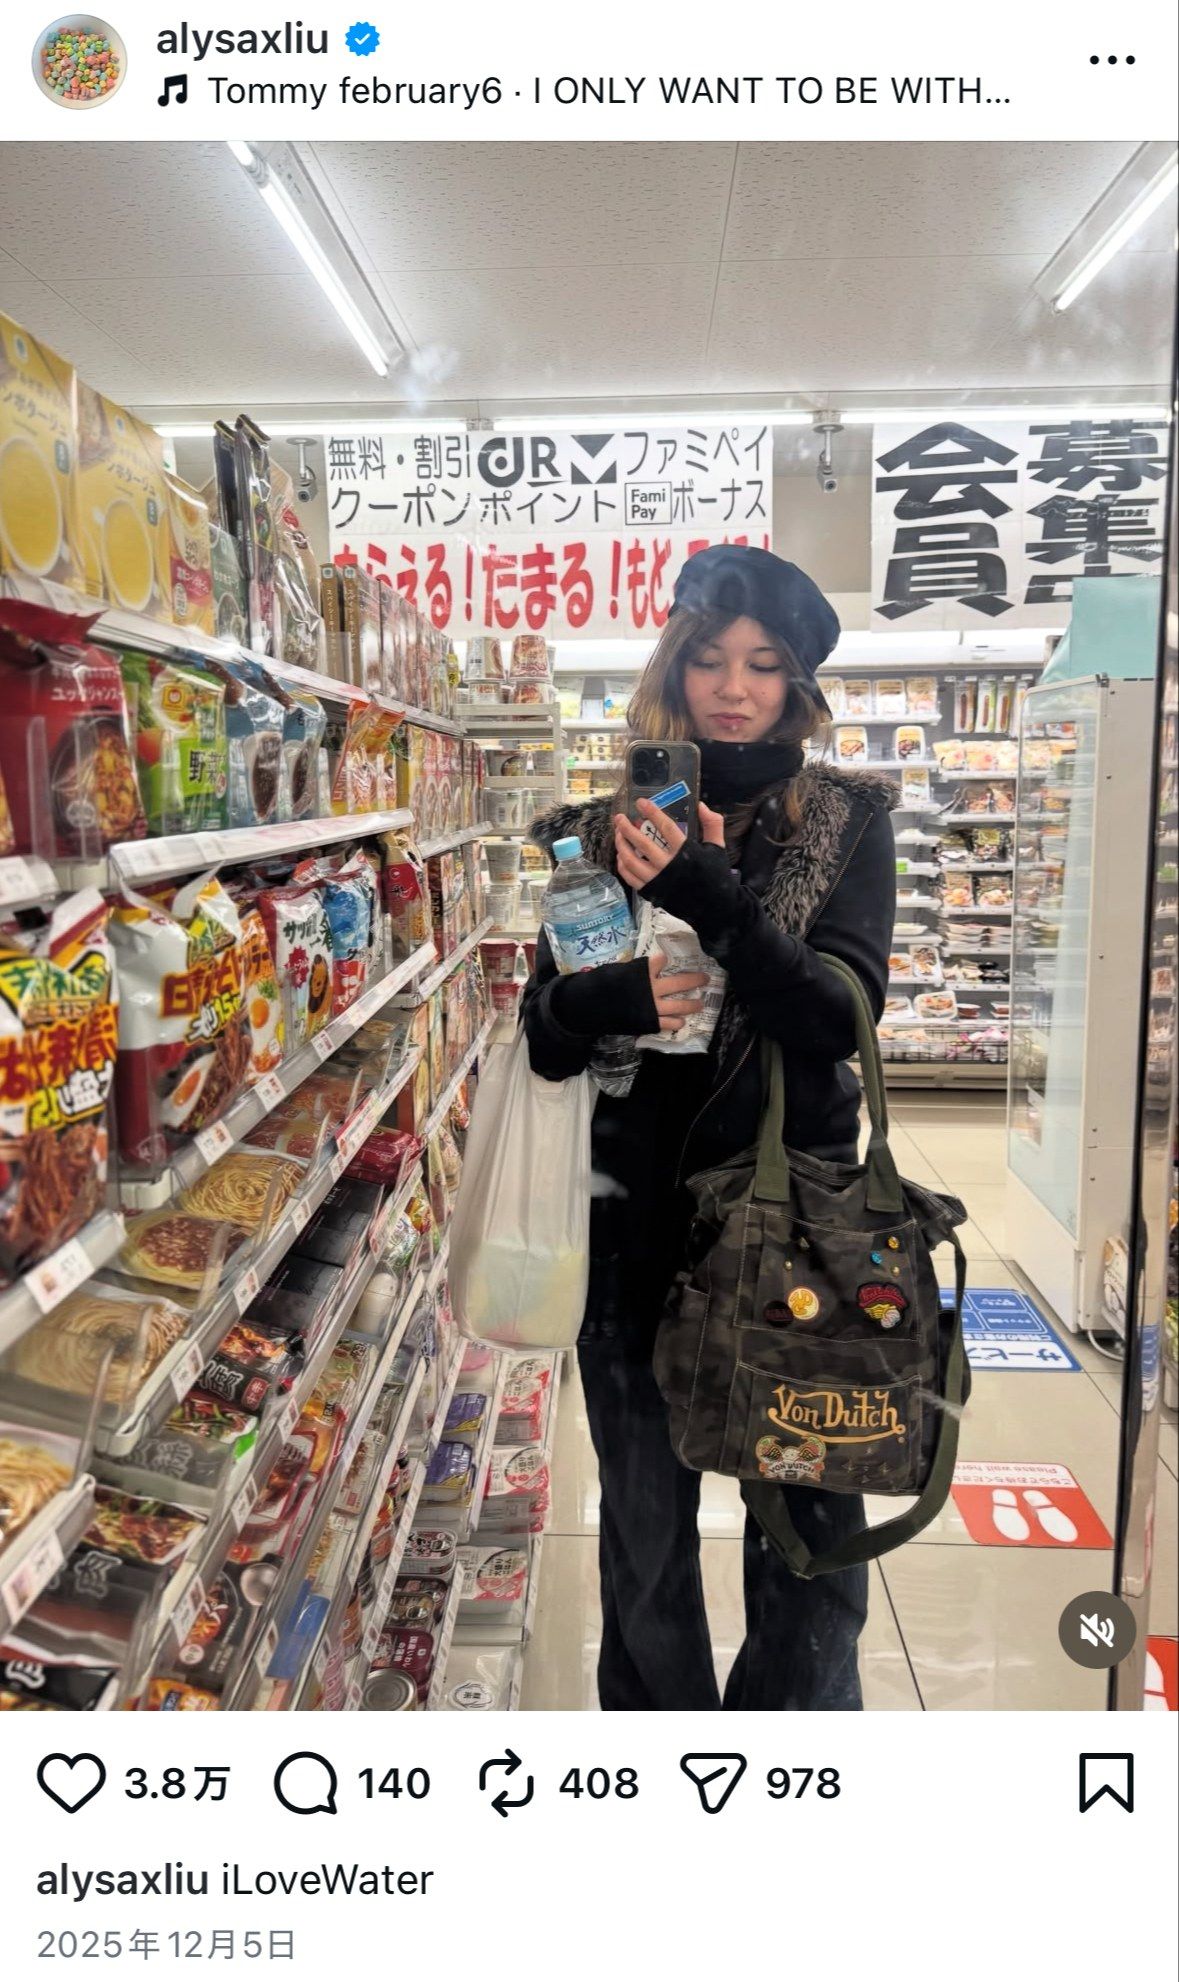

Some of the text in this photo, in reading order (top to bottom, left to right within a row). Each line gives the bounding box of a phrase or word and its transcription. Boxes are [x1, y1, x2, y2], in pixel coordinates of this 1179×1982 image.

[328, 434, 472, 481] 無料・割引
[625, 425, 769, 475] ファミペイ
[331, 484, 617, 529] クーポン ポイント
[630, 488, 667, 504] Fami
[630, 505, 657, 520] Pay
[673, 479, 767, 521] ボーナス
[873, 421, 1019, 620] 会員
[576, 925, 627, 956] 天然水
[771, 1384, 905, 1431] Von Dutch
